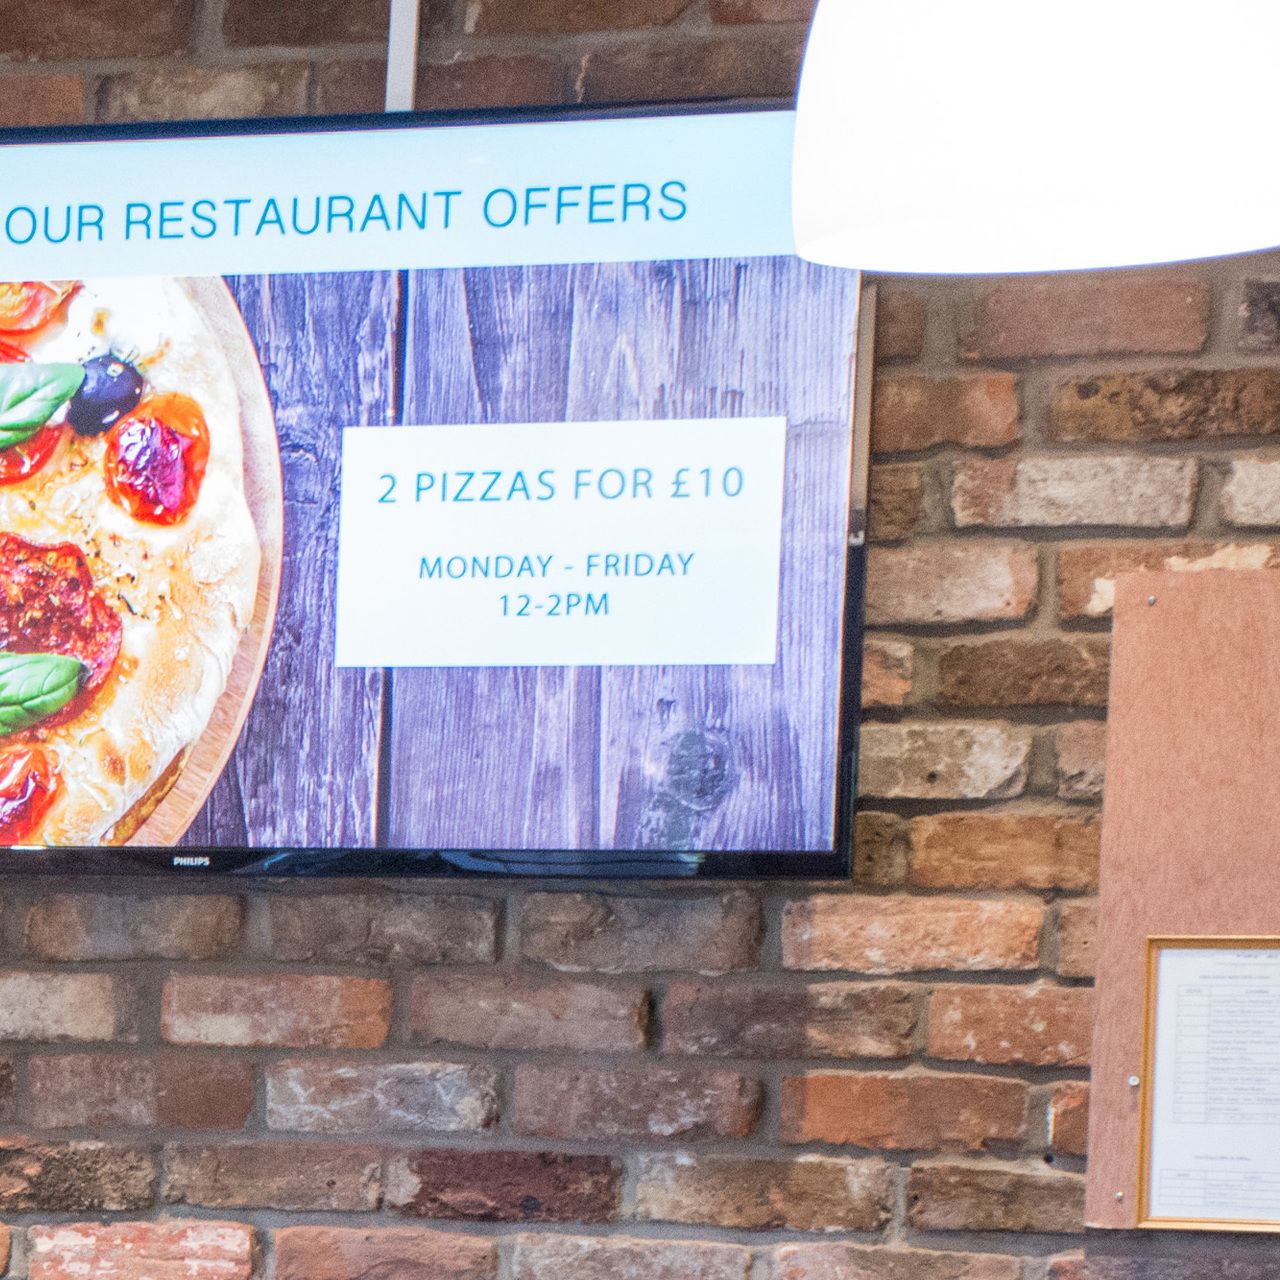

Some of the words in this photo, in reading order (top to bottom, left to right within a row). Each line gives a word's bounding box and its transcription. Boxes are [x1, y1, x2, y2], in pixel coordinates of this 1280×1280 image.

[4, 203, 105, 246] OUR
[125, 190, 463, 241] RESTAURANT
[483, 180, 688, 229] OFFERS
[377, 473, 397, 504] 2
[415, 469, 556, 503] PIZZAS
[574, 467, 653, 500] FOR
[670, 466, 744, 499] £10
[419, 554, 554, 580] MONDAY
[586, 552, 695, 577] FRIDAY
[499, 592, 609, 617] 12-2PM
[173, 856, 210, 866] PHILIPS
